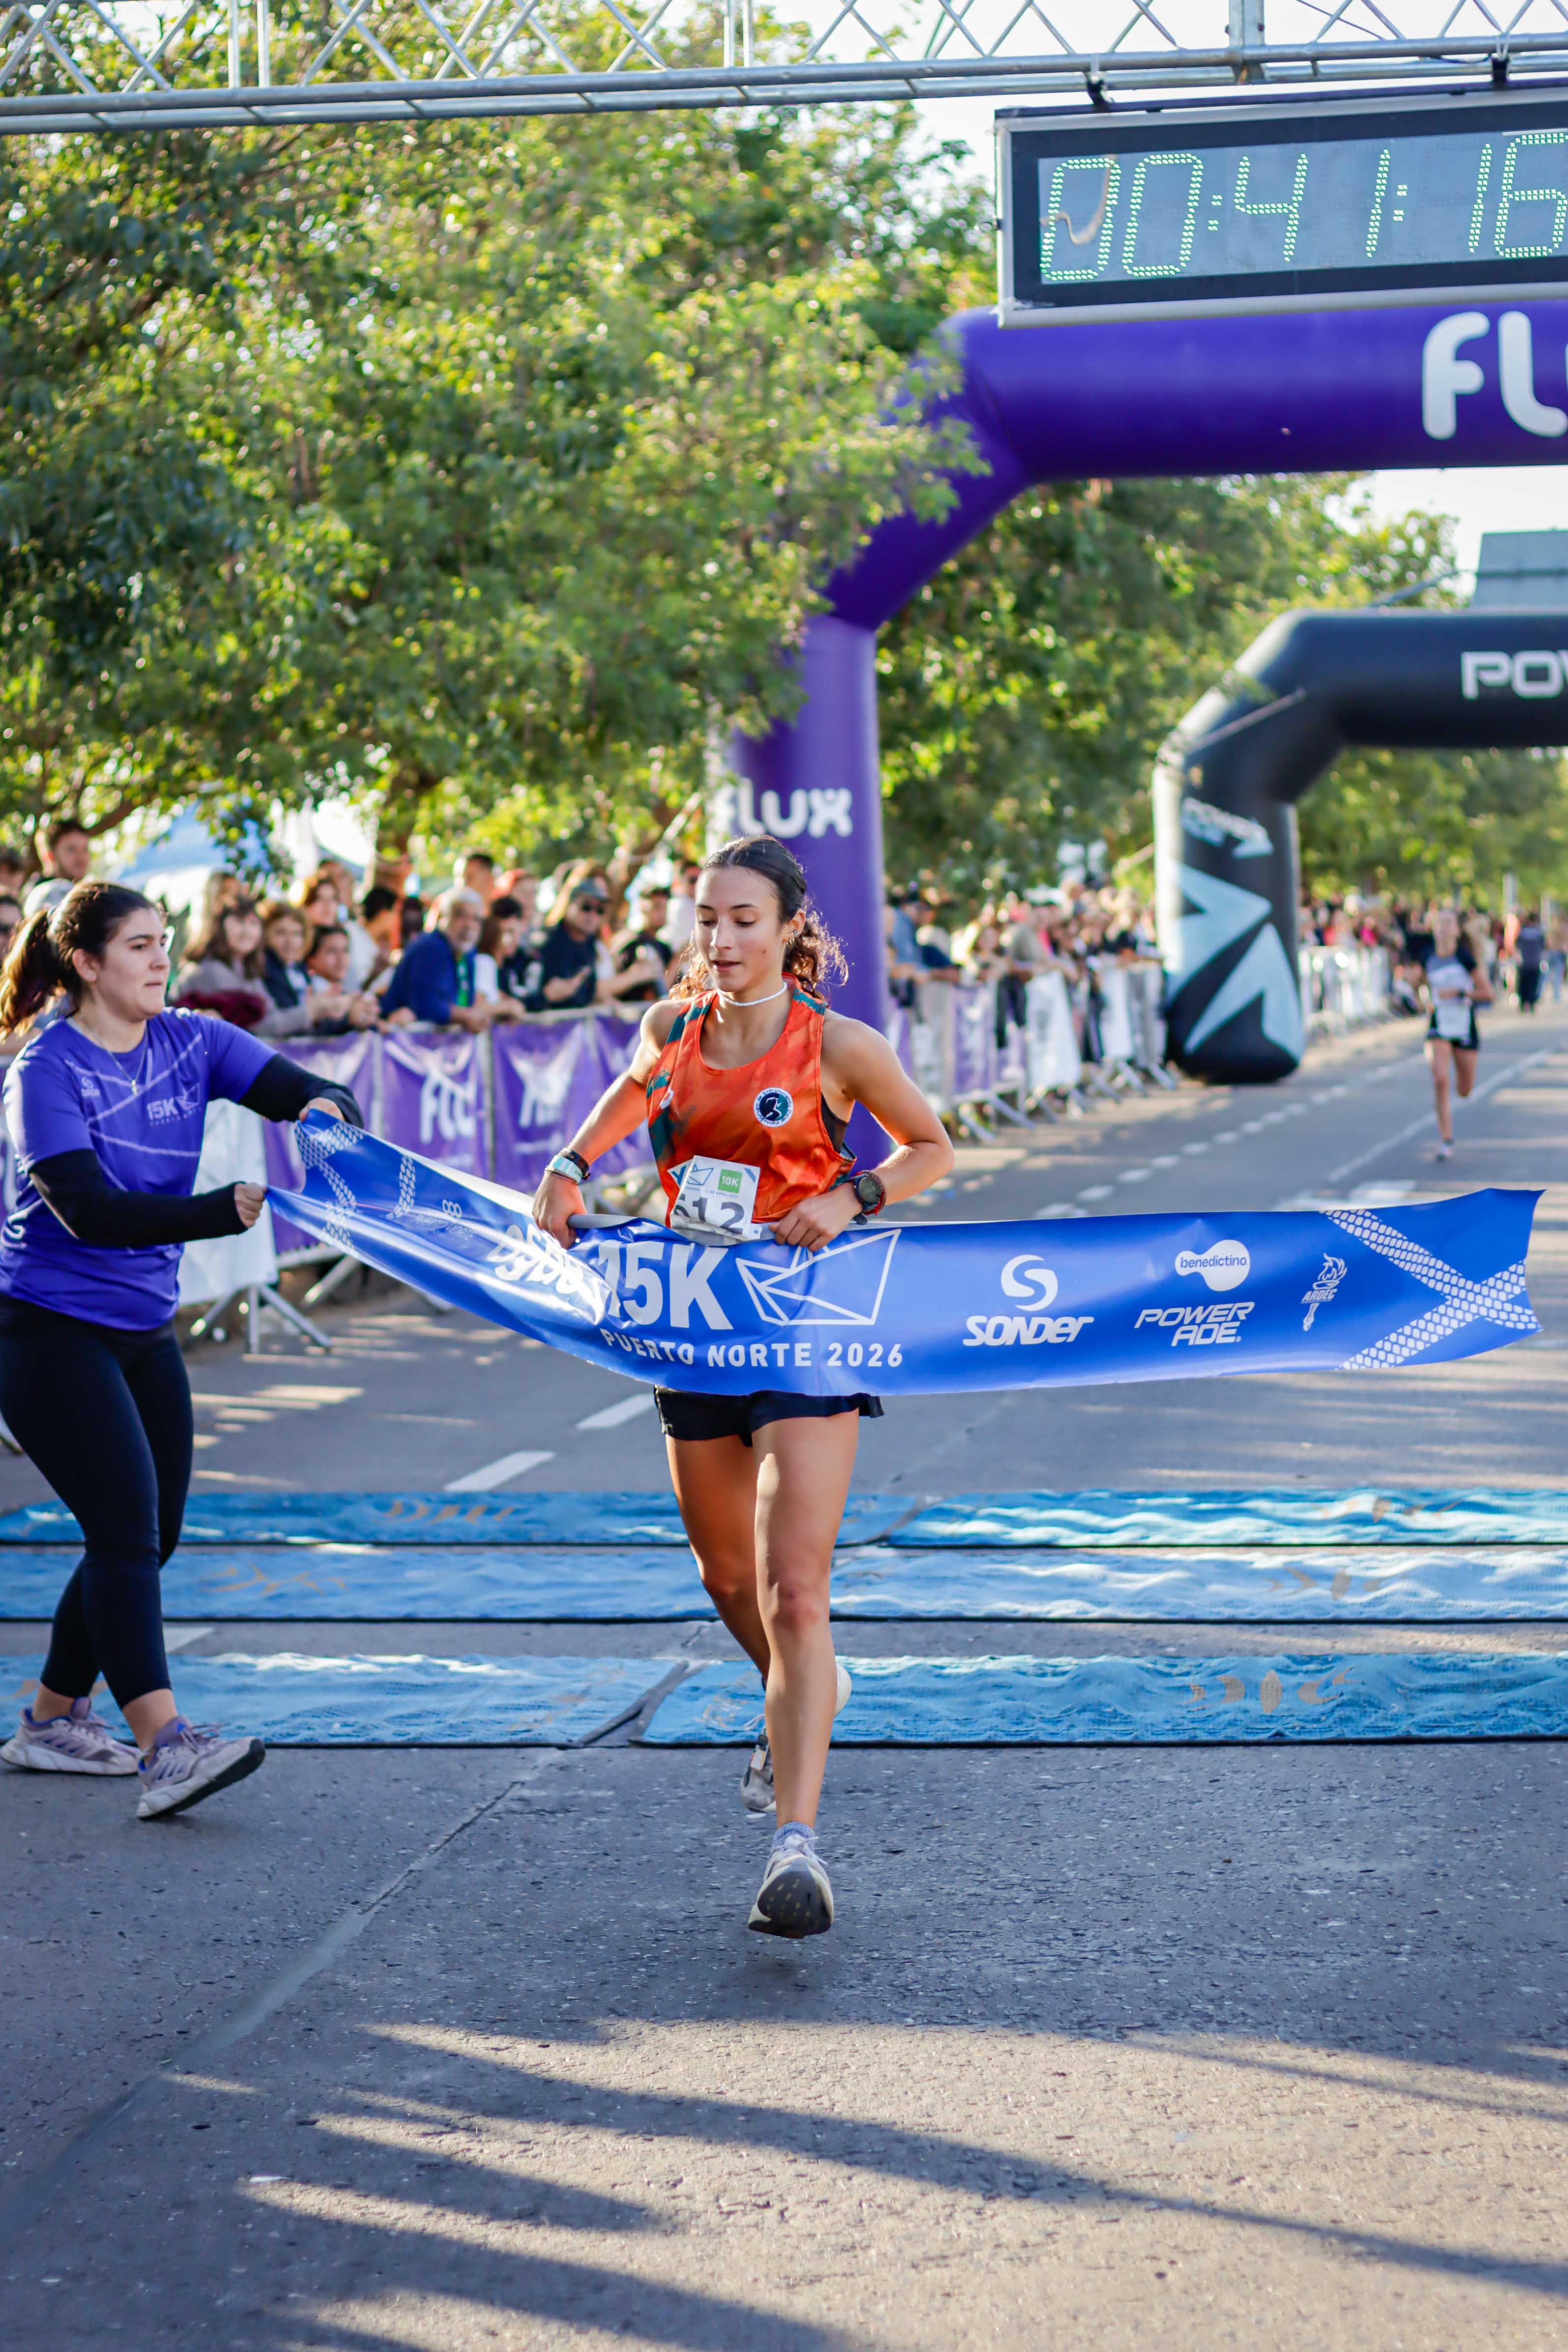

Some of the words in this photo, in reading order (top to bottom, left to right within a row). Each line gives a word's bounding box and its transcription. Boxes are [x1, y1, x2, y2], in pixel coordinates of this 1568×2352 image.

[1461, 650, 1568, 700] PO
[147, 1097, 178, 1120] 15K
[721, 1175, 739, 1187] 10K
[1180, 1255, 1247, 1268] benedictino
[598, 1239, 734, 1329] 15K
[1302, 1288, 1338, 1302] ARDEC
[1134, 1301, 1255, 1328] POWER
[600, 1328, 694, 1365] PUERTO
[707, 1343, 812, 1367] NORTE
[827, 1343, 903, 1367] 2026
